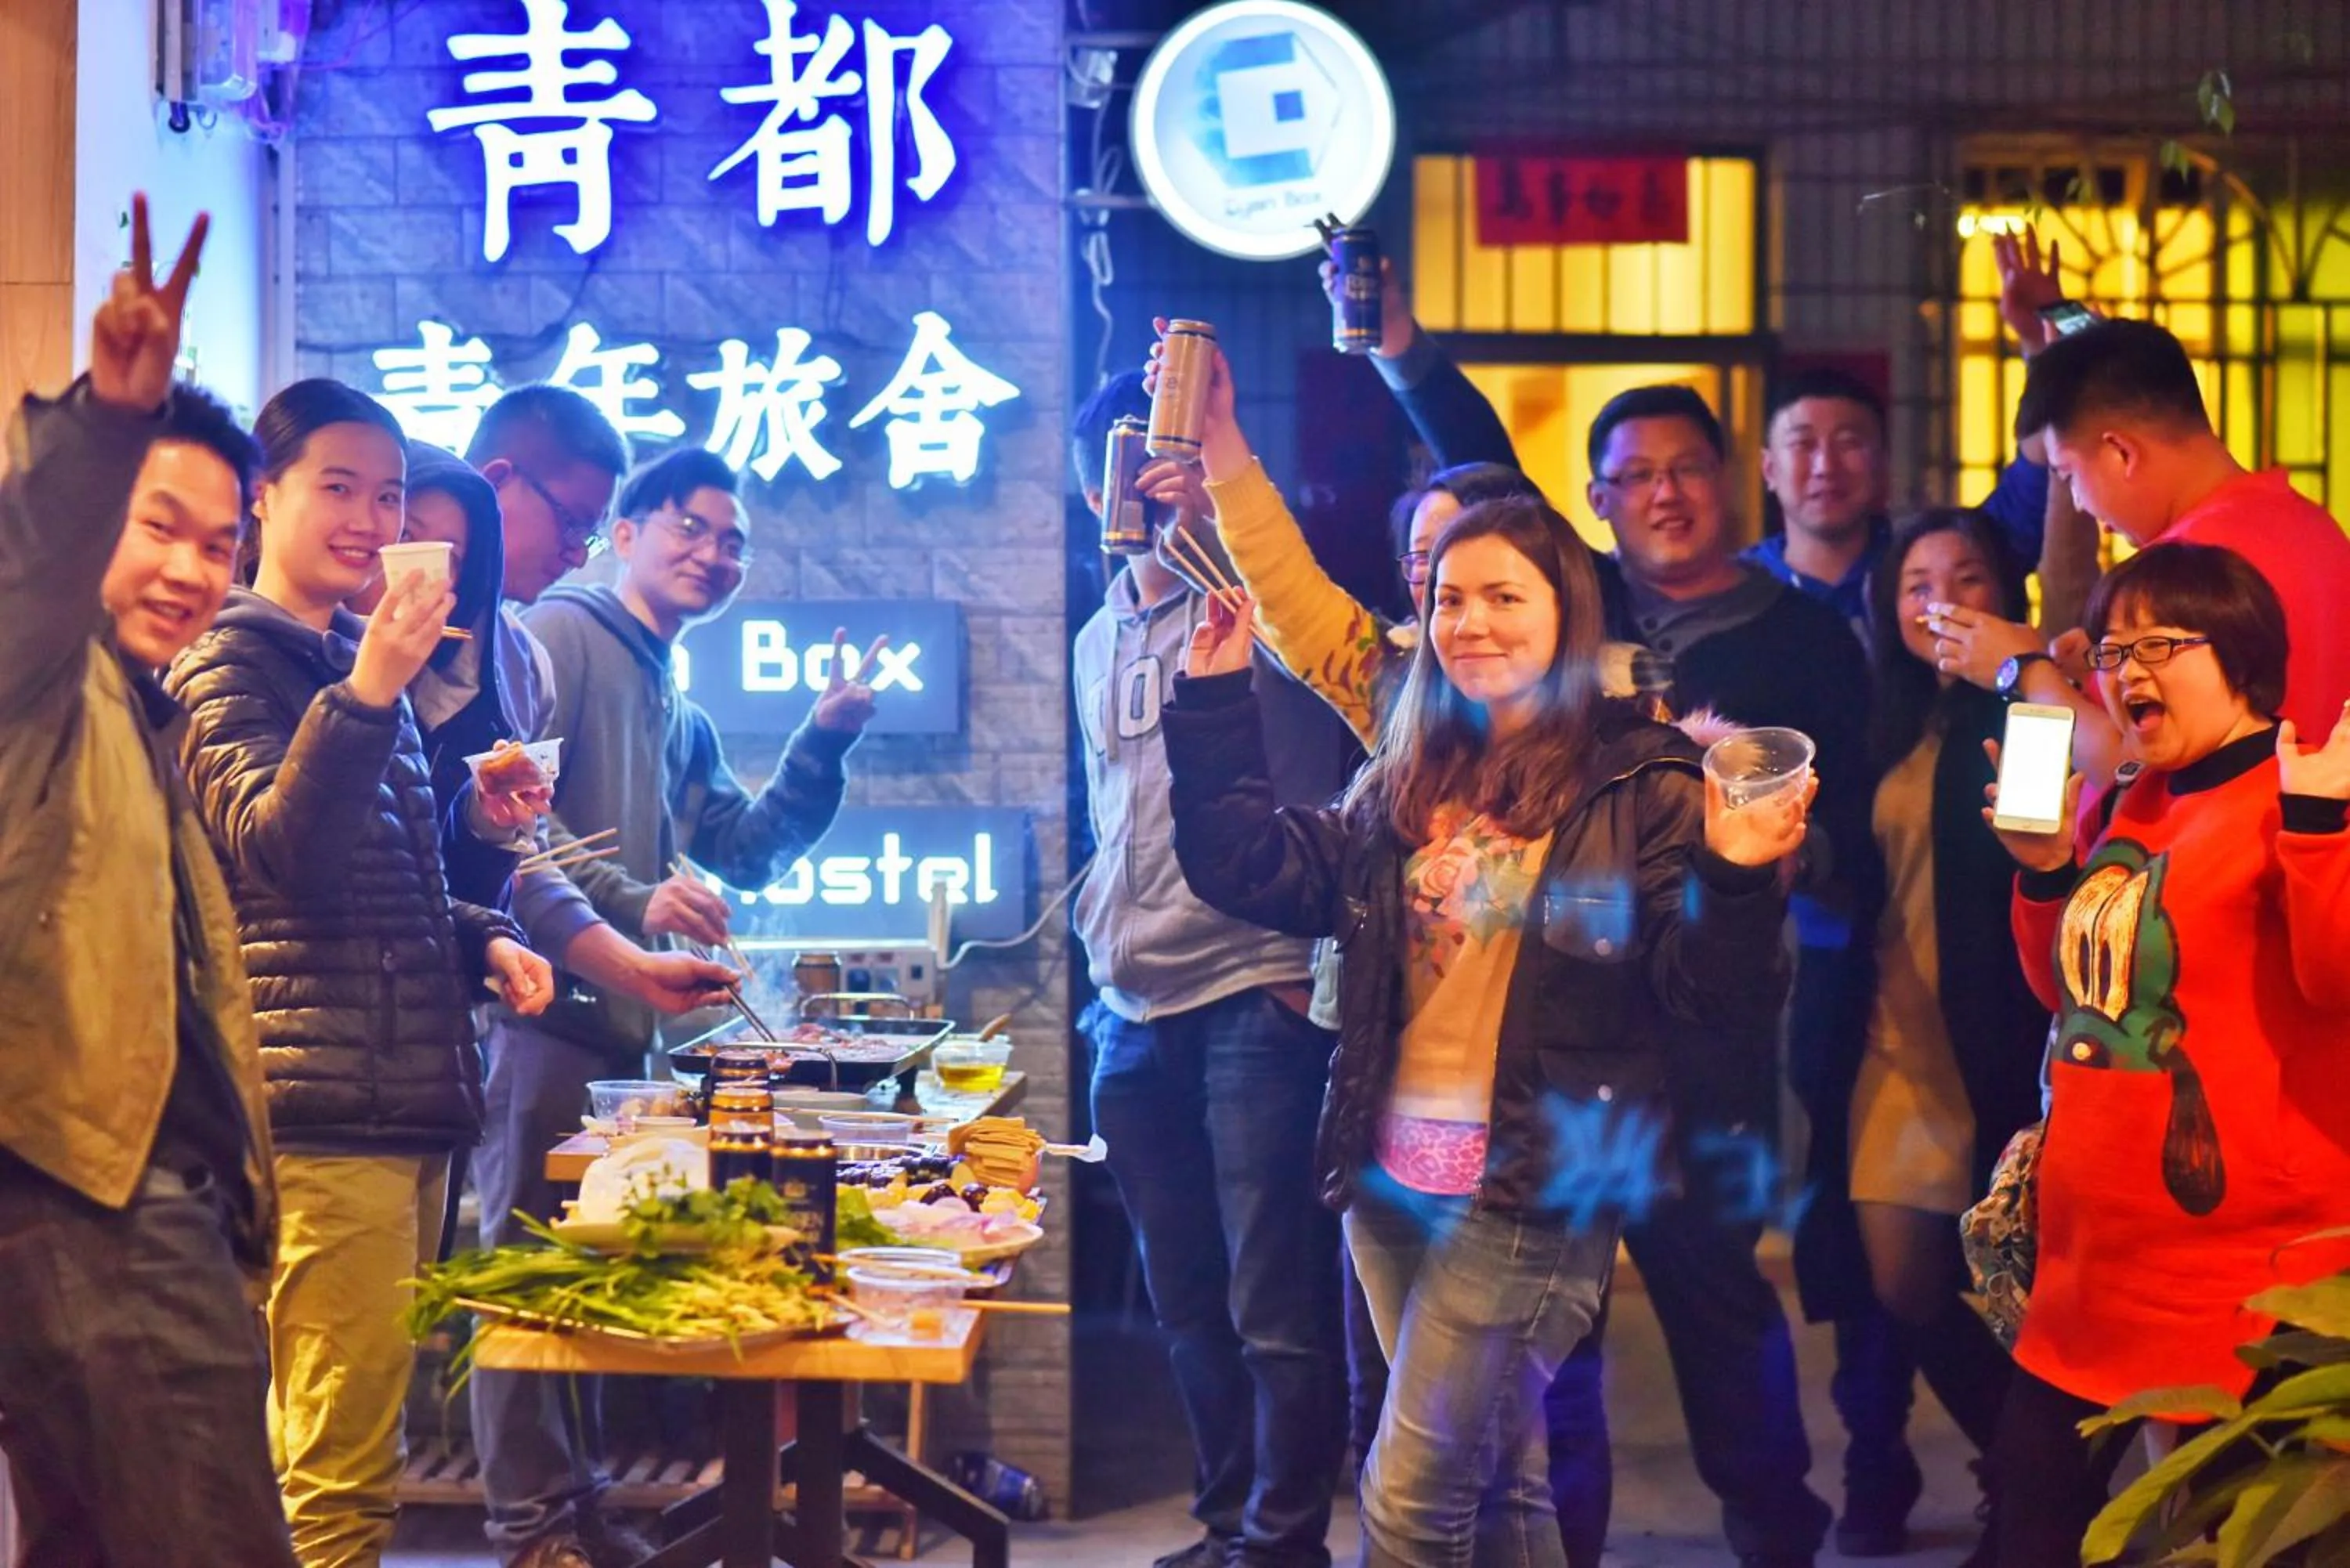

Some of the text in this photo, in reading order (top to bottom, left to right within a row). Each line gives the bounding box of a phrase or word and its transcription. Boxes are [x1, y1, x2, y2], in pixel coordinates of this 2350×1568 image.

[427, 0, 956, 262] 青都
[372, 311, 1021, 490] 青年旅舍
[742, 620, 924, 692] Box
[705, 832, 998, 905] ostel
